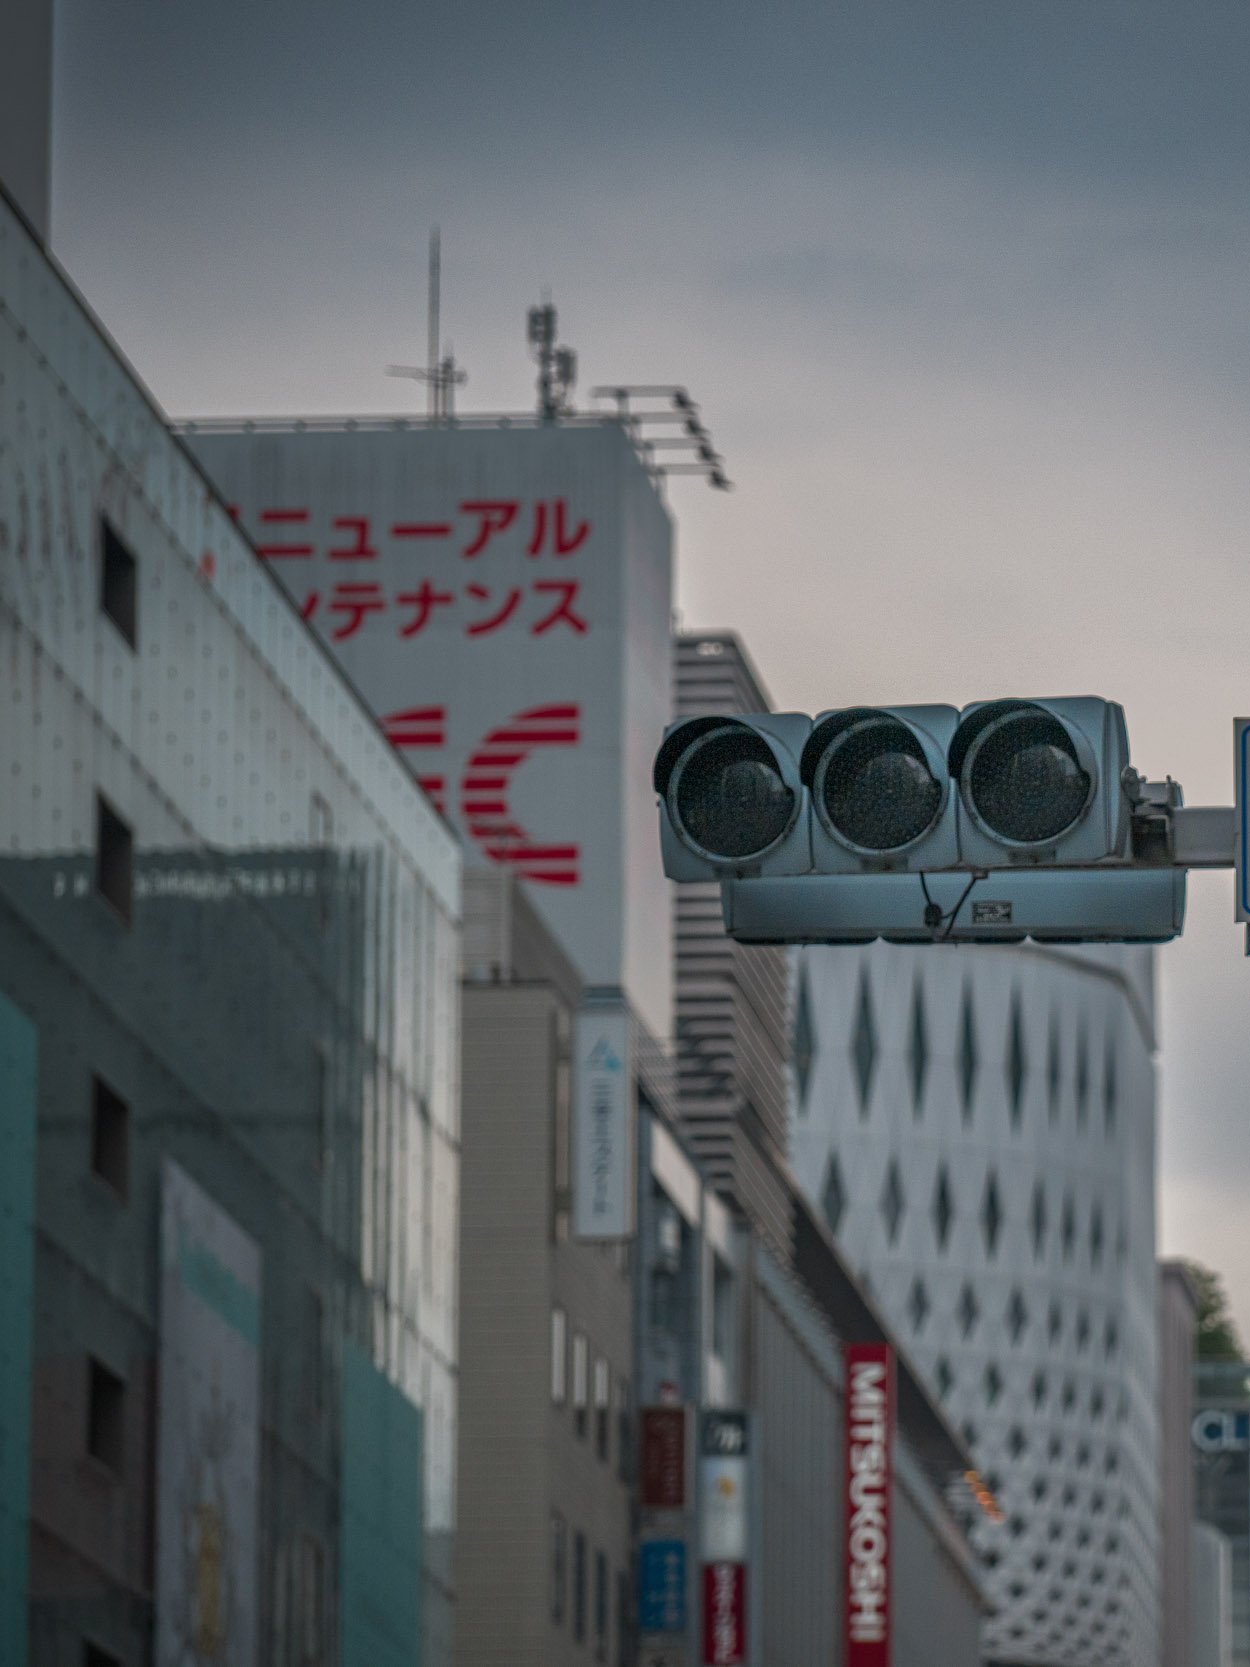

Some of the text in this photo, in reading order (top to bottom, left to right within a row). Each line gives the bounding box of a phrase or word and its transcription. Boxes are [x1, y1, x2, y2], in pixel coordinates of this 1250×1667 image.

[230, 497, 591, 562] ニューアル
[848, 1360, 888, 1643] MITSUKOSHI
